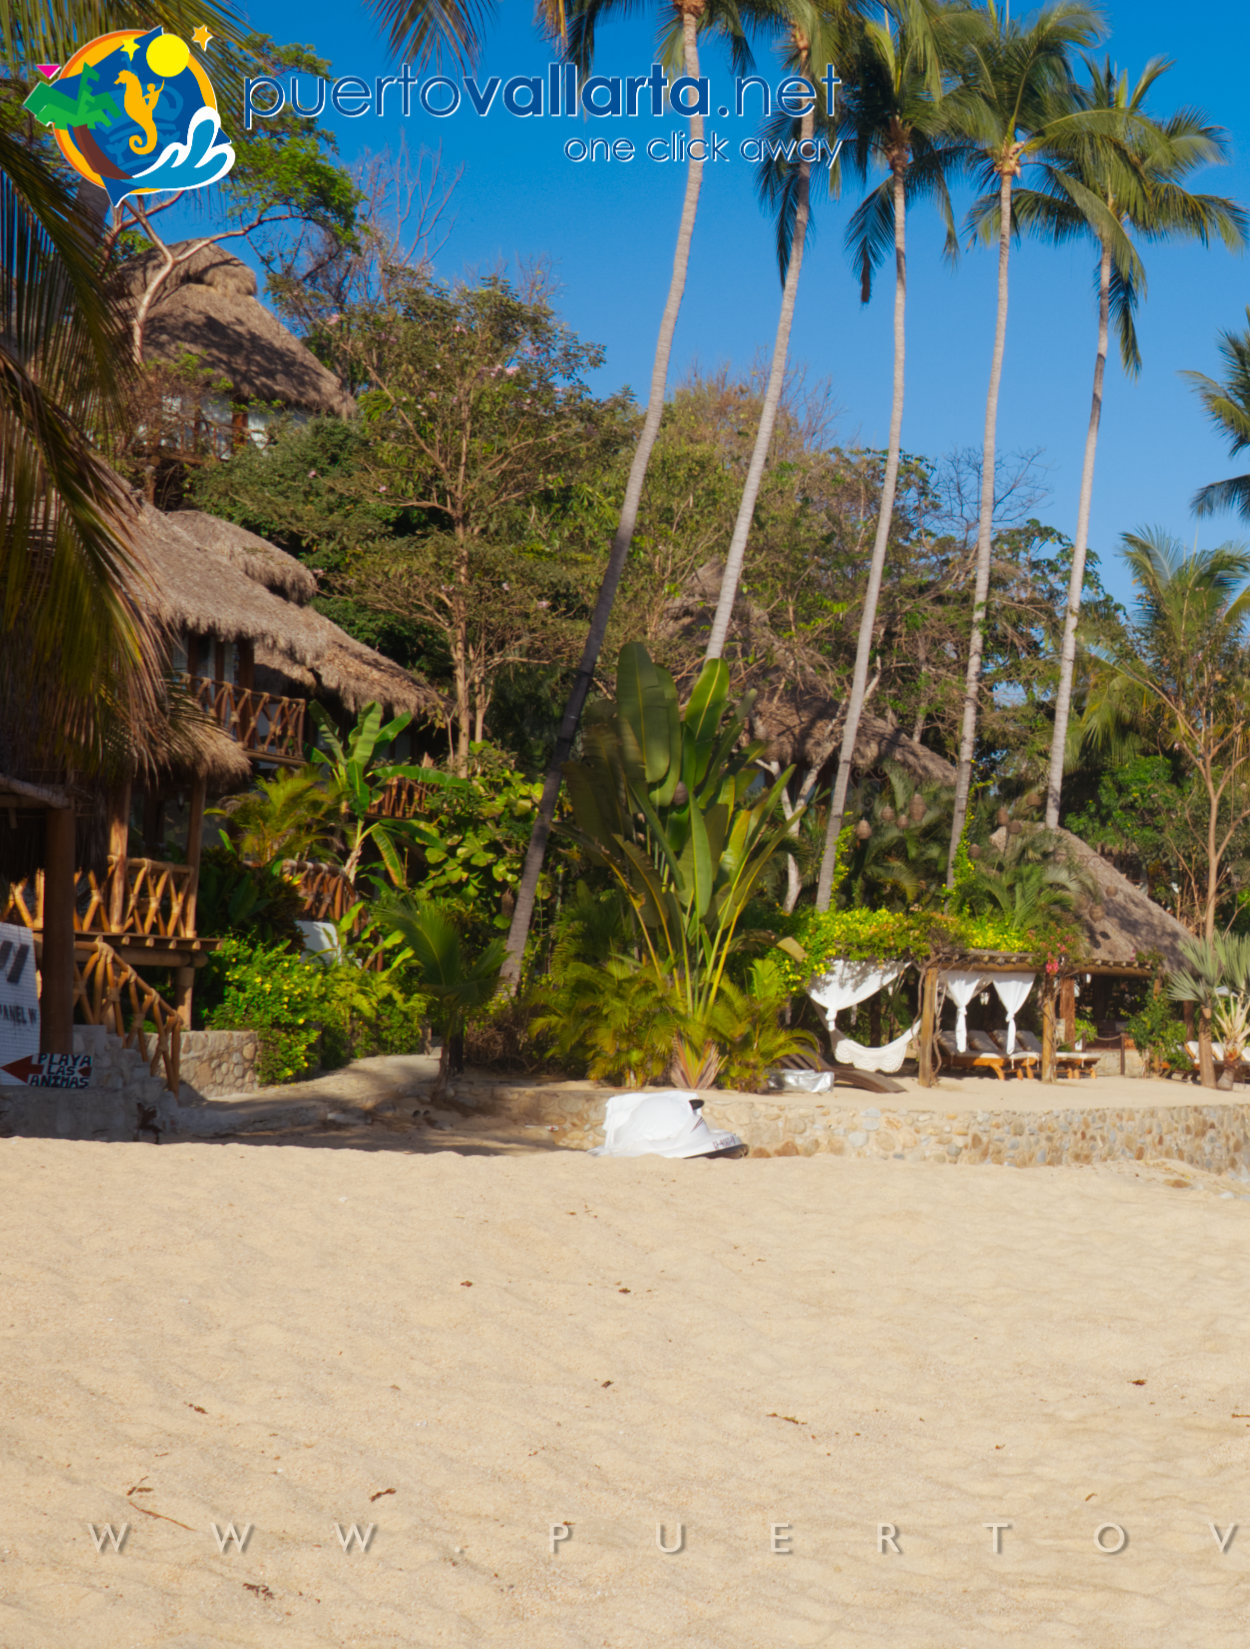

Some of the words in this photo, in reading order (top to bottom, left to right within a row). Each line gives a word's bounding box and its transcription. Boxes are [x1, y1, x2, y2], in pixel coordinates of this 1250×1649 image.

[38, 1053, 92, 1066] PLAYA
[47, 1065, 76, 1075] LAS
[29, 1074, 89, 1088] ANIMAS
